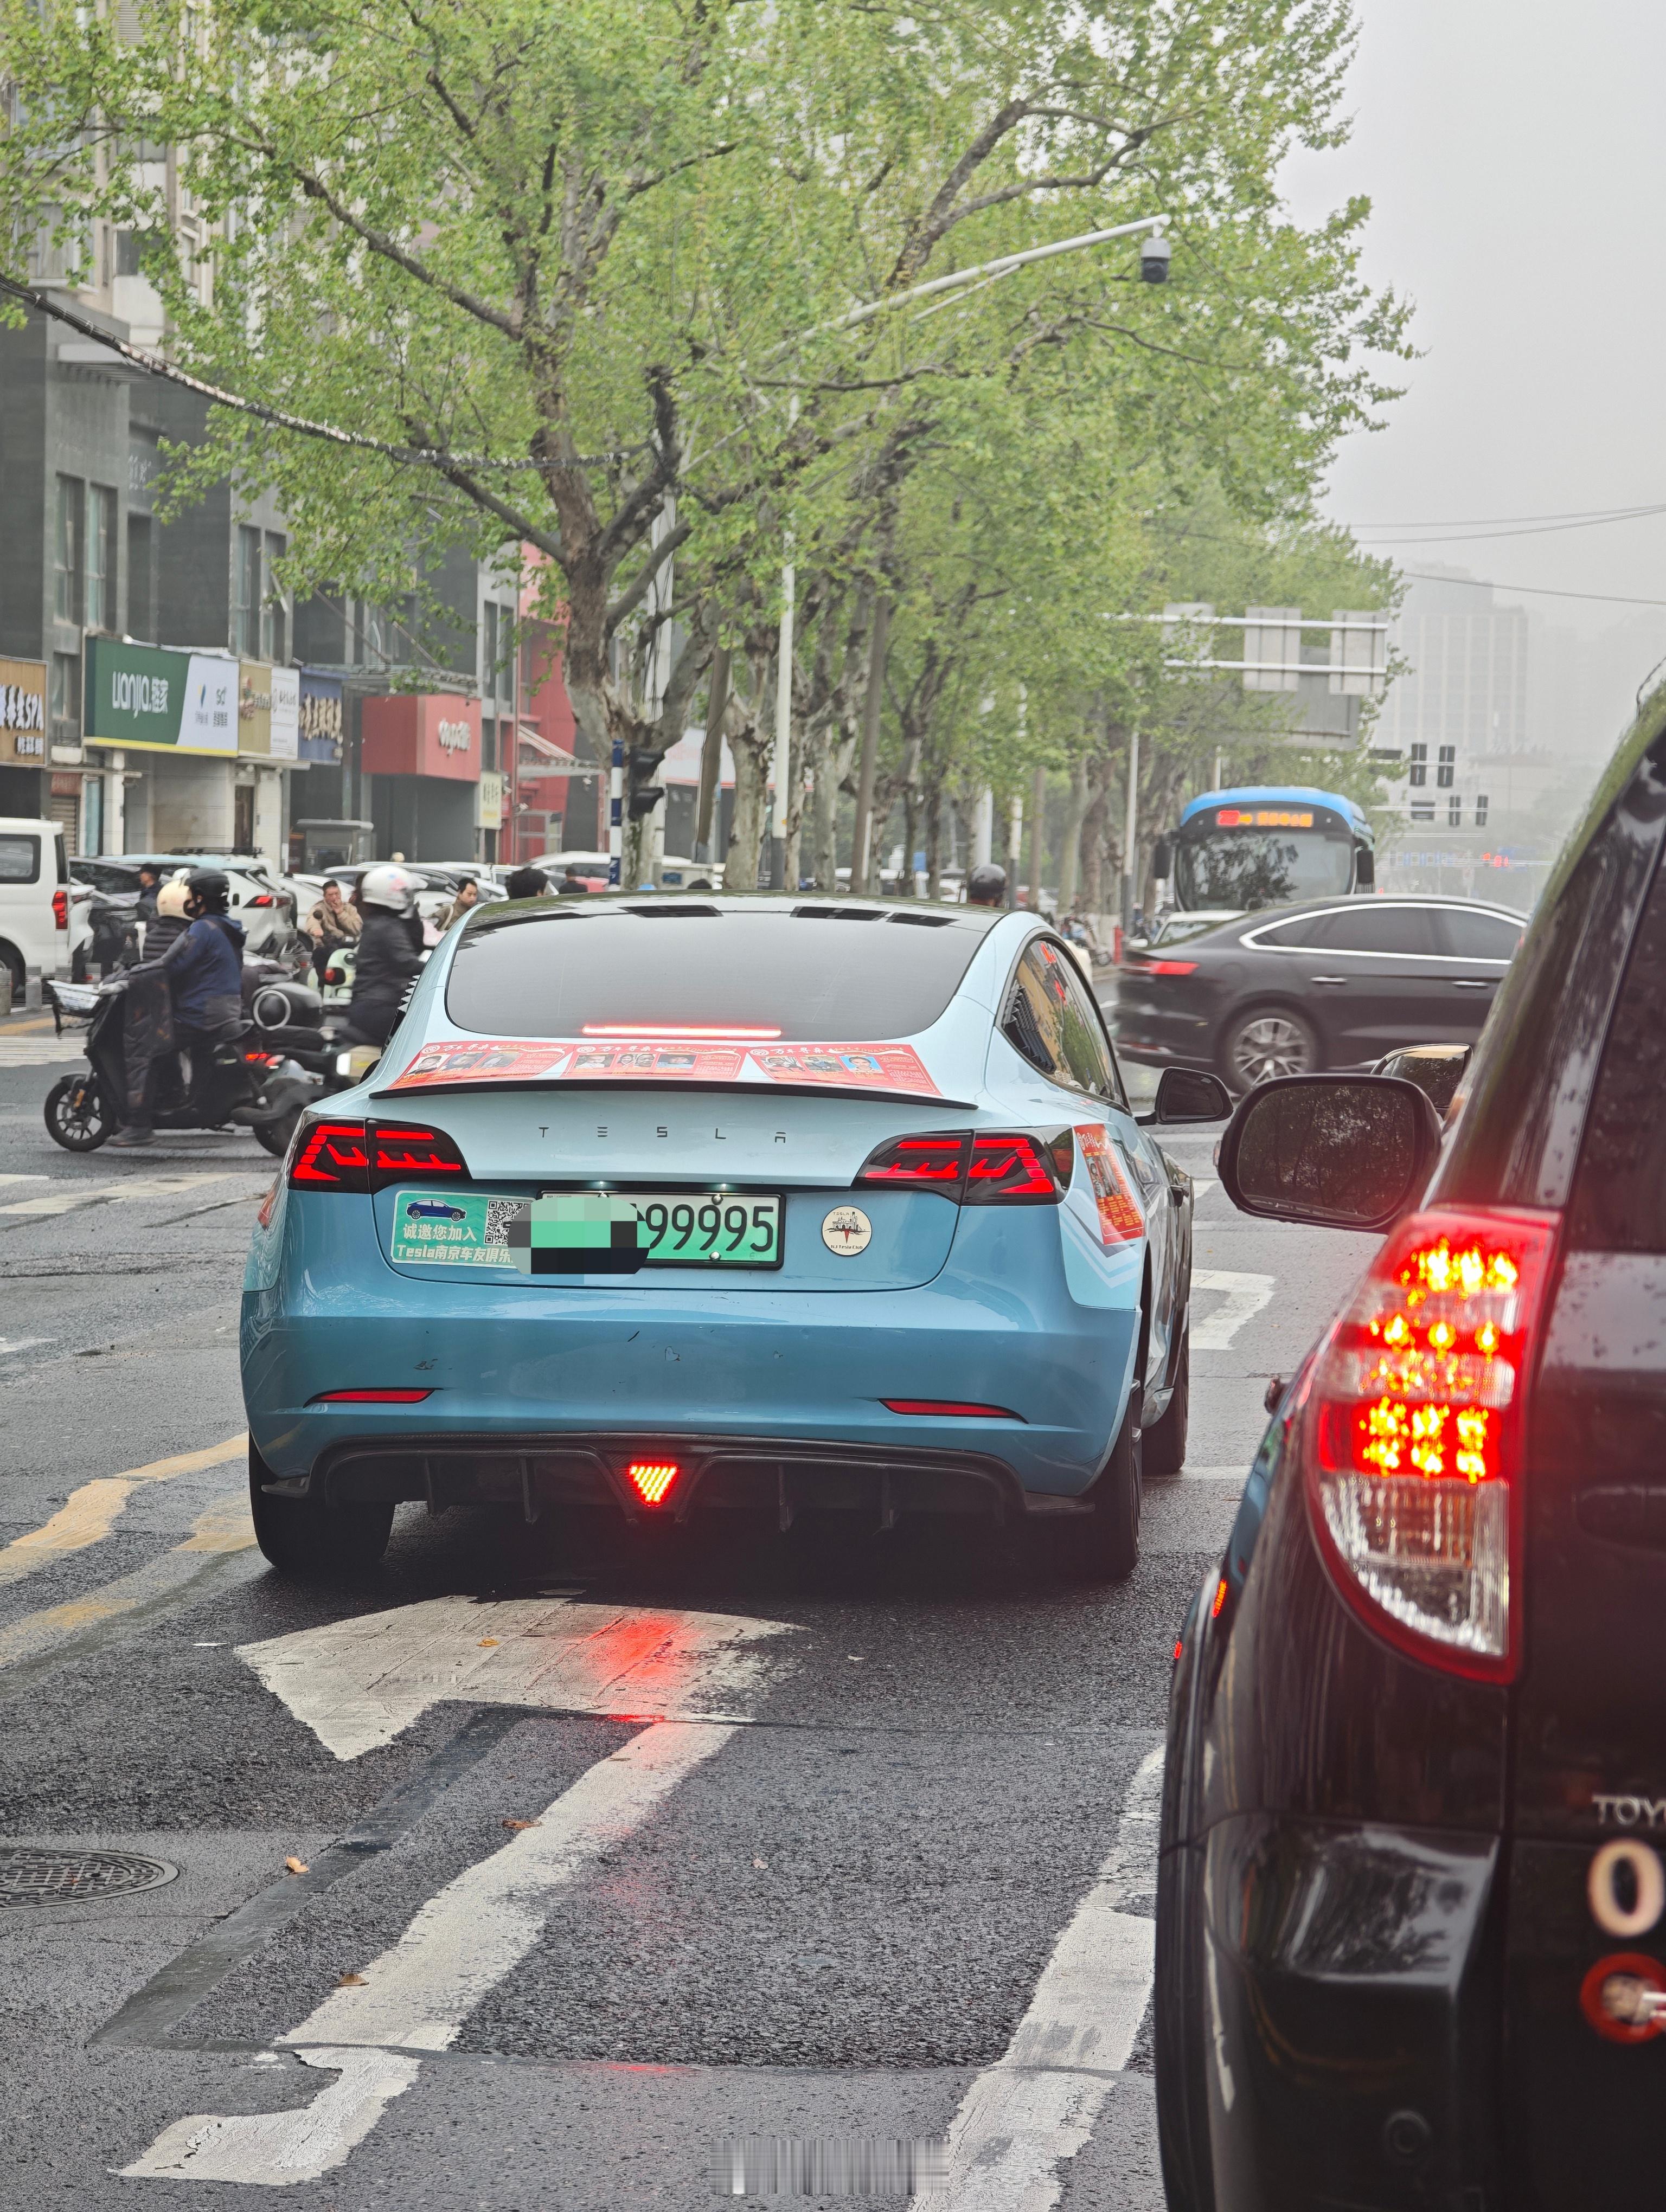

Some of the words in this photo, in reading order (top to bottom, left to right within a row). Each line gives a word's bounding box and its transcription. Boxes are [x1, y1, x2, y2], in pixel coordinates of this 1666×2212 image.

[539, 1126, 786, 1143] TESLA
[403, 1223, 477, 1242] 诚邀您加入
[636, 1202, 774, 1252] 99995
[397, 1244, 514, 1263] Tesla南京车友俱乐
[1592, 1794, 1666, 1827] TOY
